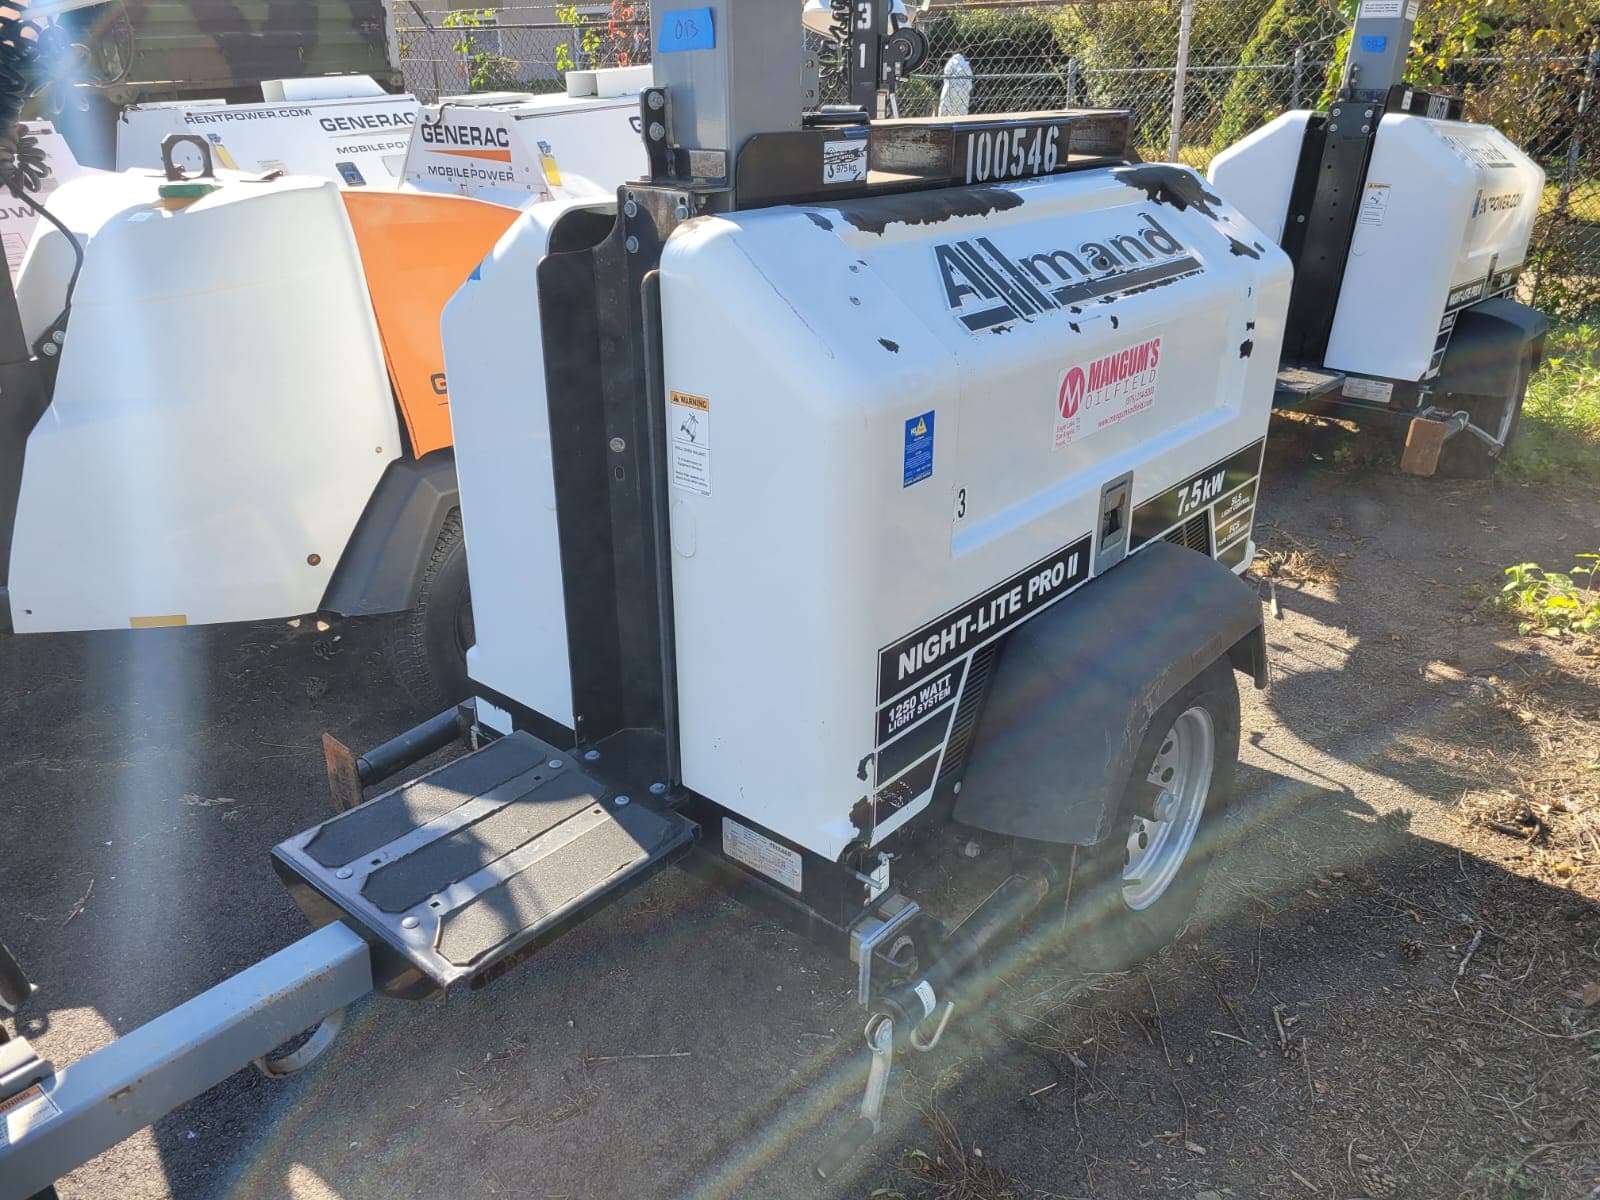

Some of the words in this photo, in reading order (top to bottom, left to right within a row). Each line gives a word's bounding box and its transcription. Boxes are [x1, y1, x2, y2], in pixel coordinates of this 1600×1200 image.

[184, 107, 313, 126] RENTPOWER.COM
[319, 111, 418, 133] GENERAC
[421, 123, 510, 148] GENERAC
[427, 164, 515, 183] MOBILEPOWER
[965, 124, 1060, 186] 100546
[932, 212, 1190, 322] Allmand
[1086, 337, 1161, 394] MANGUM'S
[680, 396, 707, 410] WARNING
[1085, 369, 1157, 410] OILFIELD
[957, 487, 966, 519] 3
[898, 583, 1023, 681] NIGHT-LITE
[1027, 561, 1065, 604] PRO
[888, 695, 917, 723] 1250
[919, 673, 952, 703] WATT
[888, 708, 916, 734] LIGHT
[917, 685, 951, 715] SYSTEM
